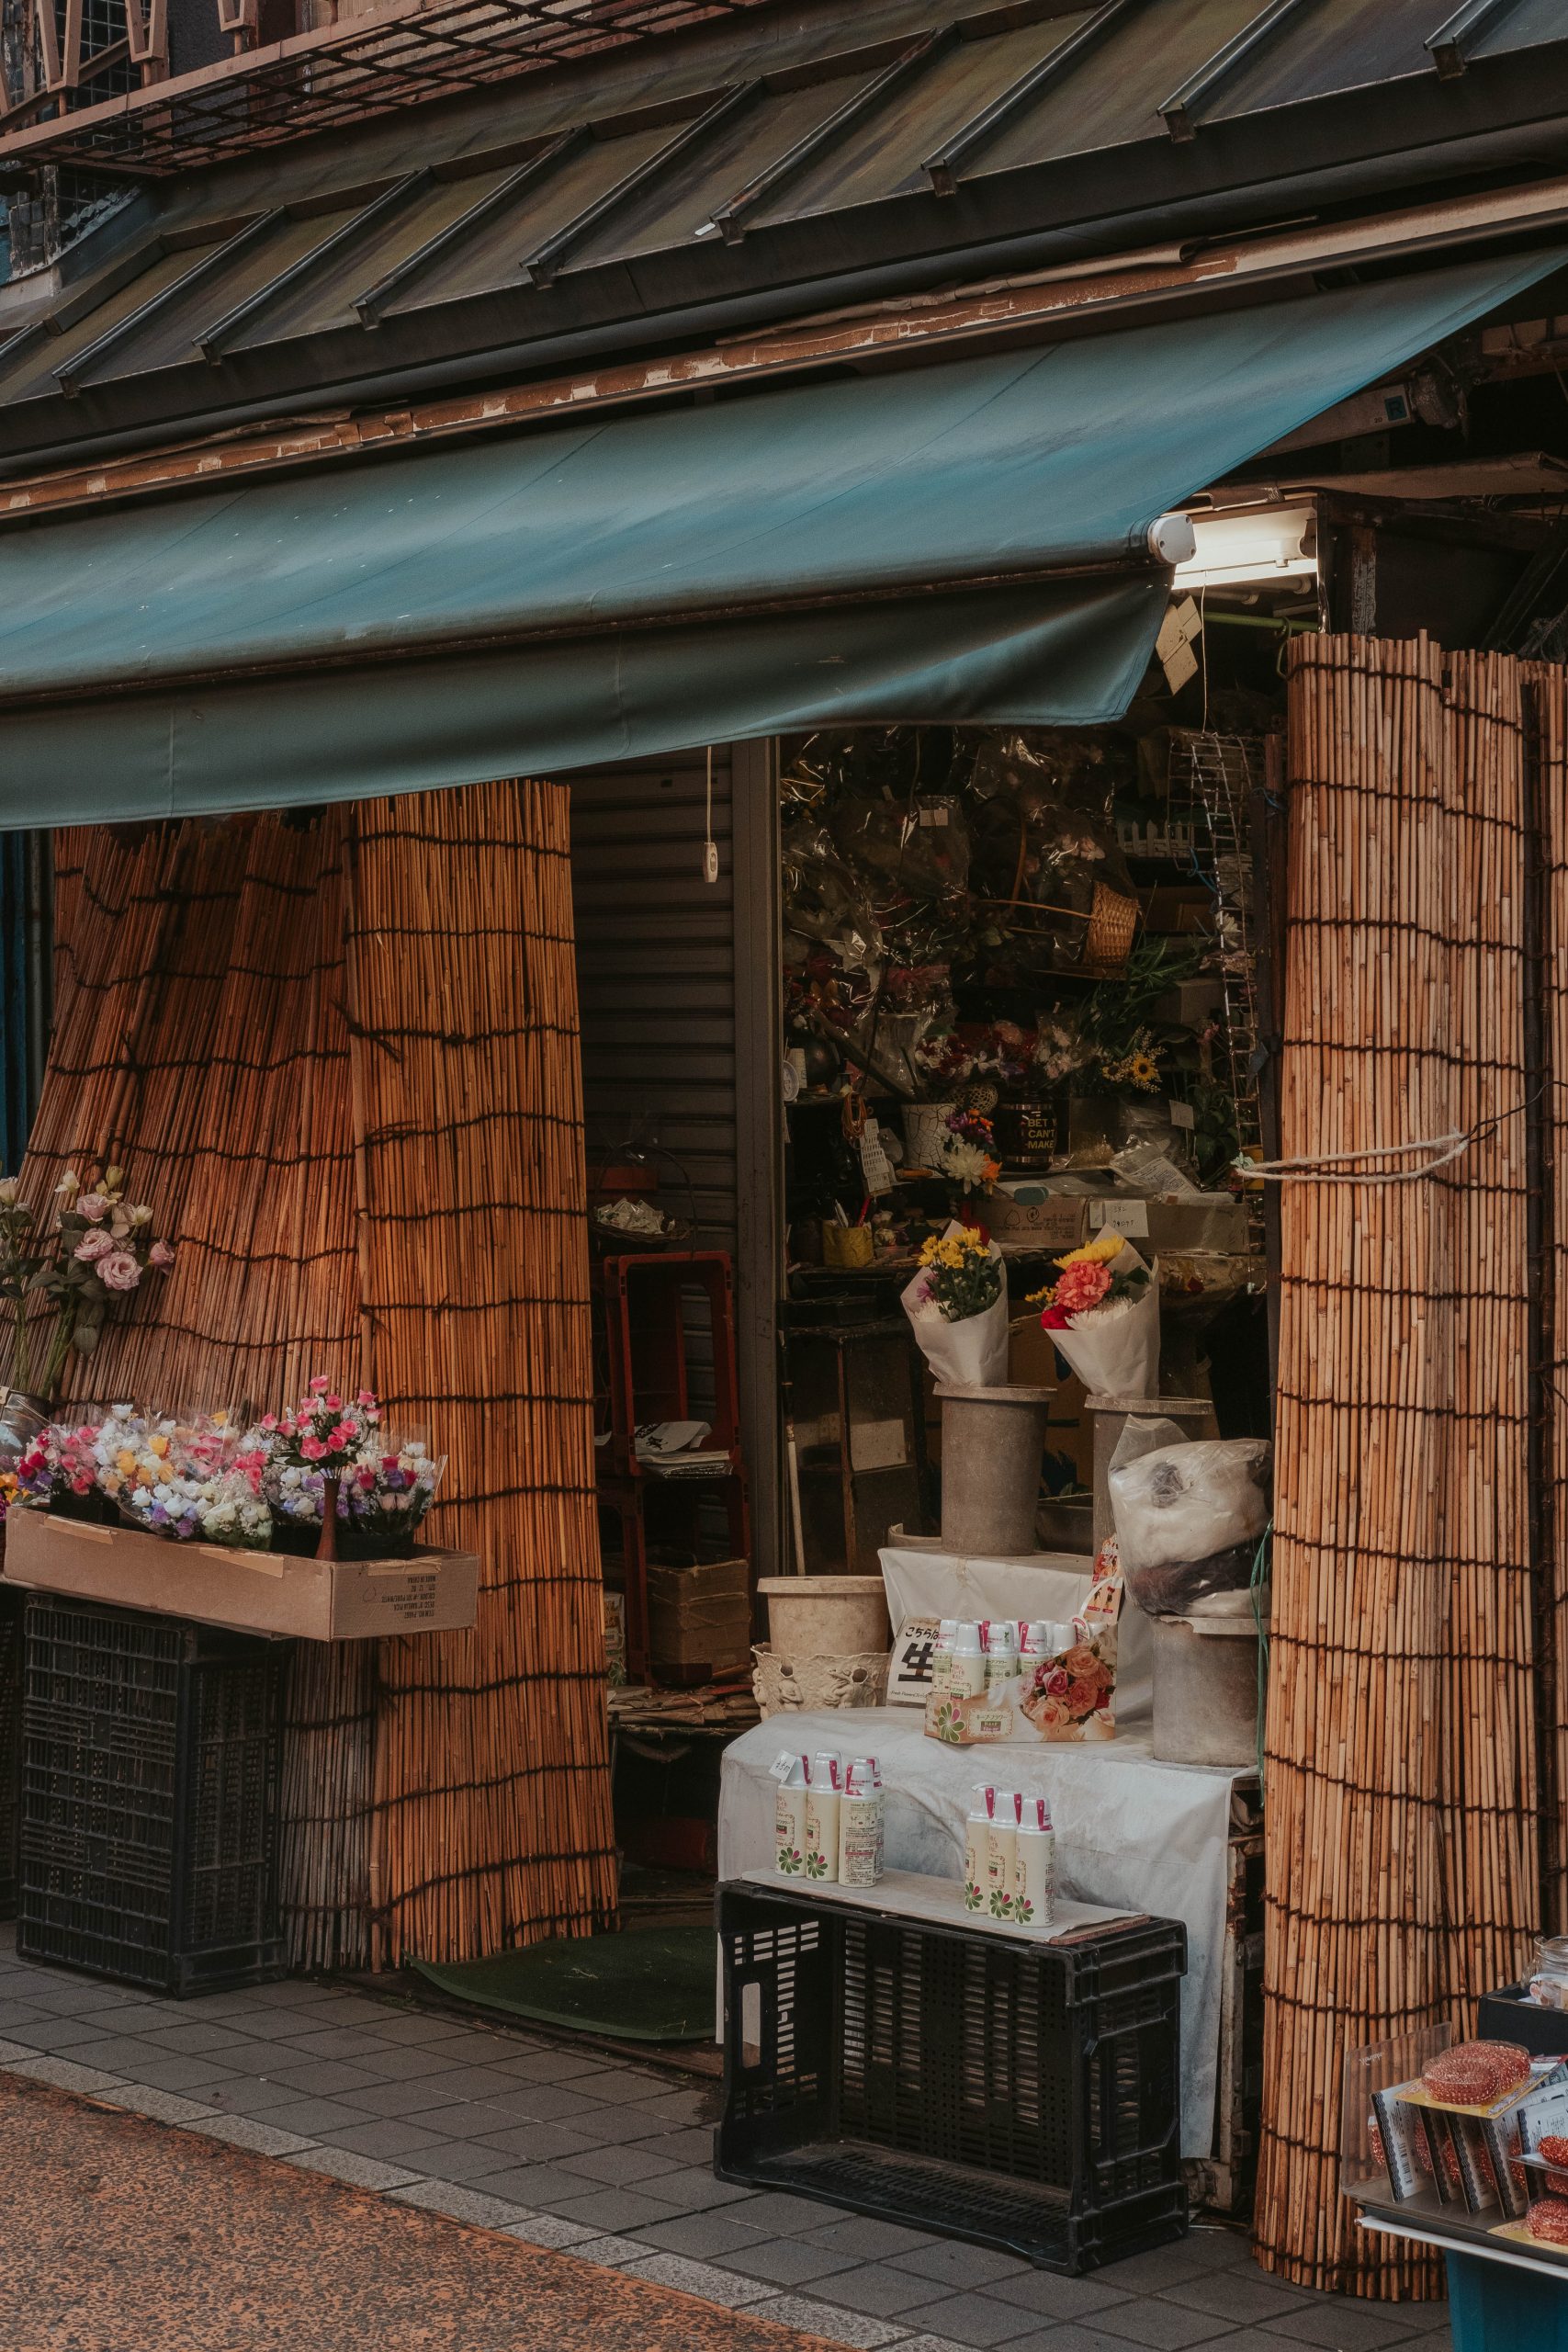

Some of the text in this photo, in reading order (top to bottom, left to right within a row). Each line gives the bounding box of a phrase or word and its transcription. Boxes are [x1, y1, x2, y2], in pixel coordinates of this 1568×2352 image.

[1028, 1118, 1048, 1127] BET
[1028, 1129, 1055, 1138] CAN'T
[1028, 1140, 1055, 1149] MAKE
[905, 1626, 939, 1640] こちらは
